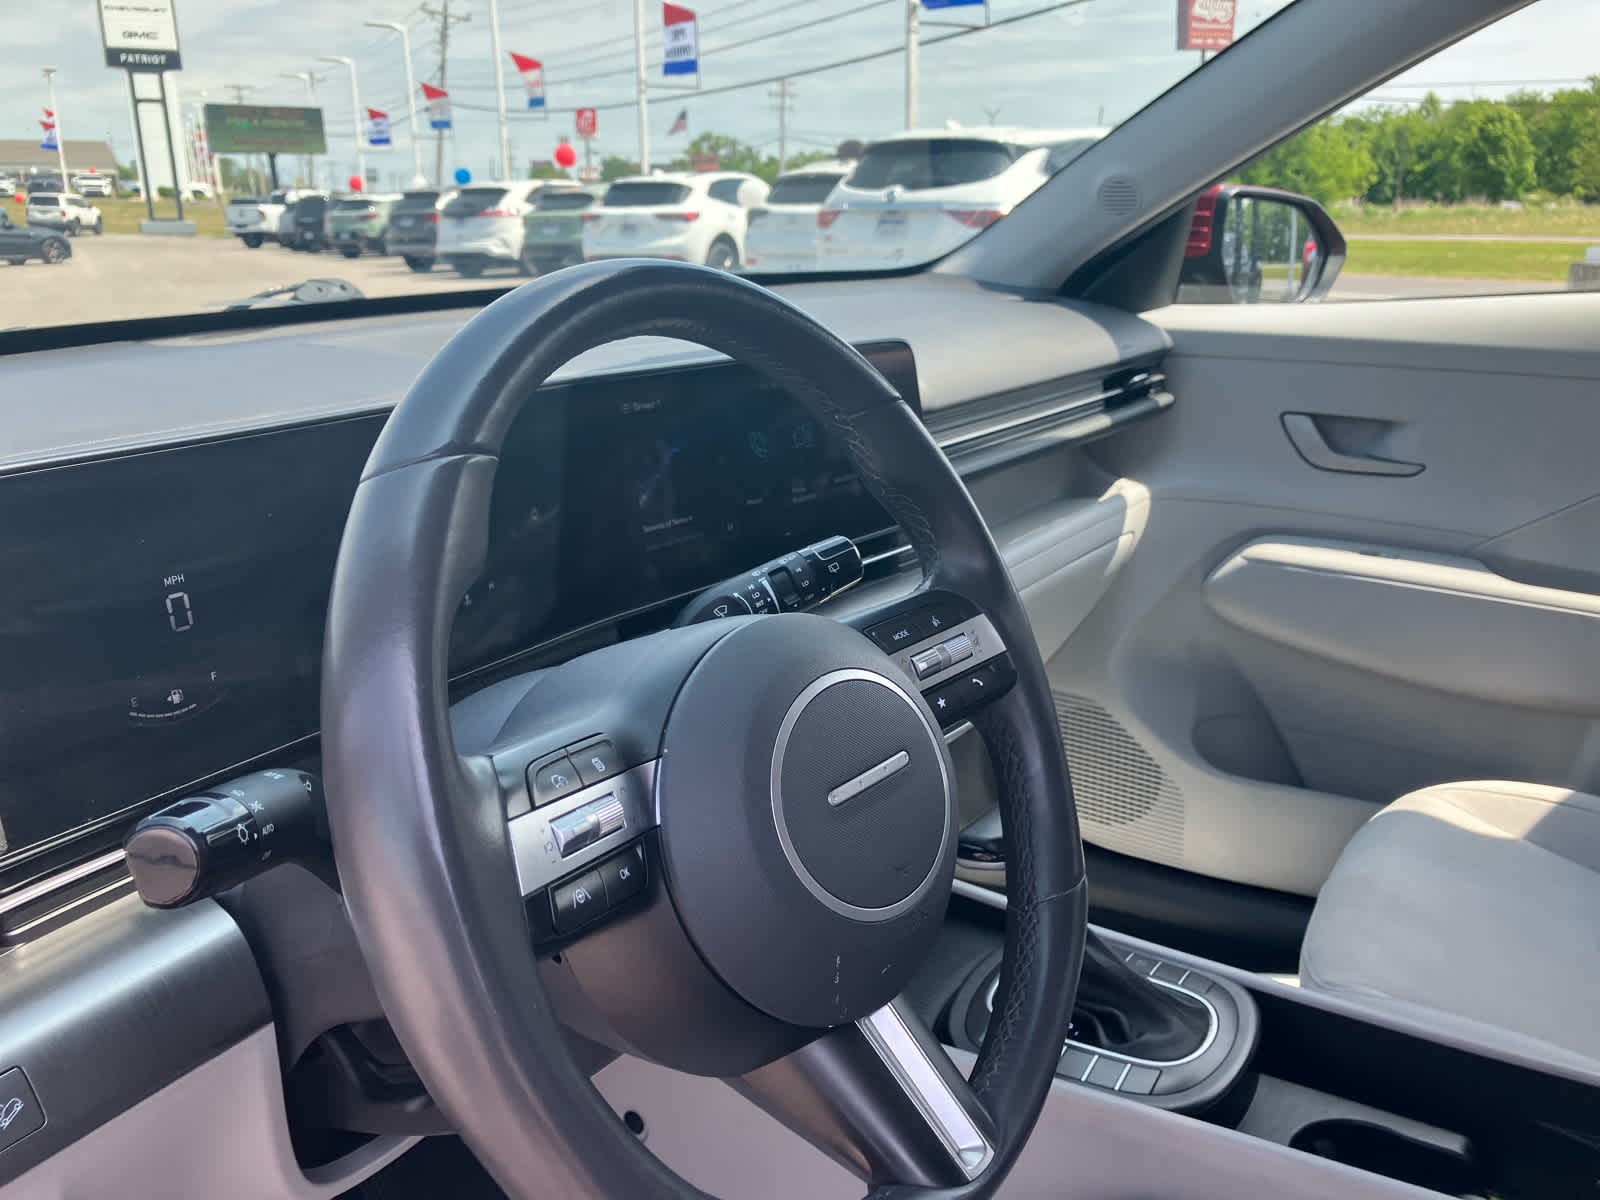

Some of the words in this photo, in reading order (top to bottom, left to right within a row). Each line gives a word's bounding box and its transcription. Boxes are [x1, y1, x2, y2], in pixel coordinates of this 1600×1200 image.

[120, 53, 167, 64] PATRIOT
[164, 574, 185, 587] MPH
[165, 592, 194, 632] 0
[210, 671, 217, 680] F
[262, 823, 275, 836] AUTO
[619, 865, 631, 879] OK
